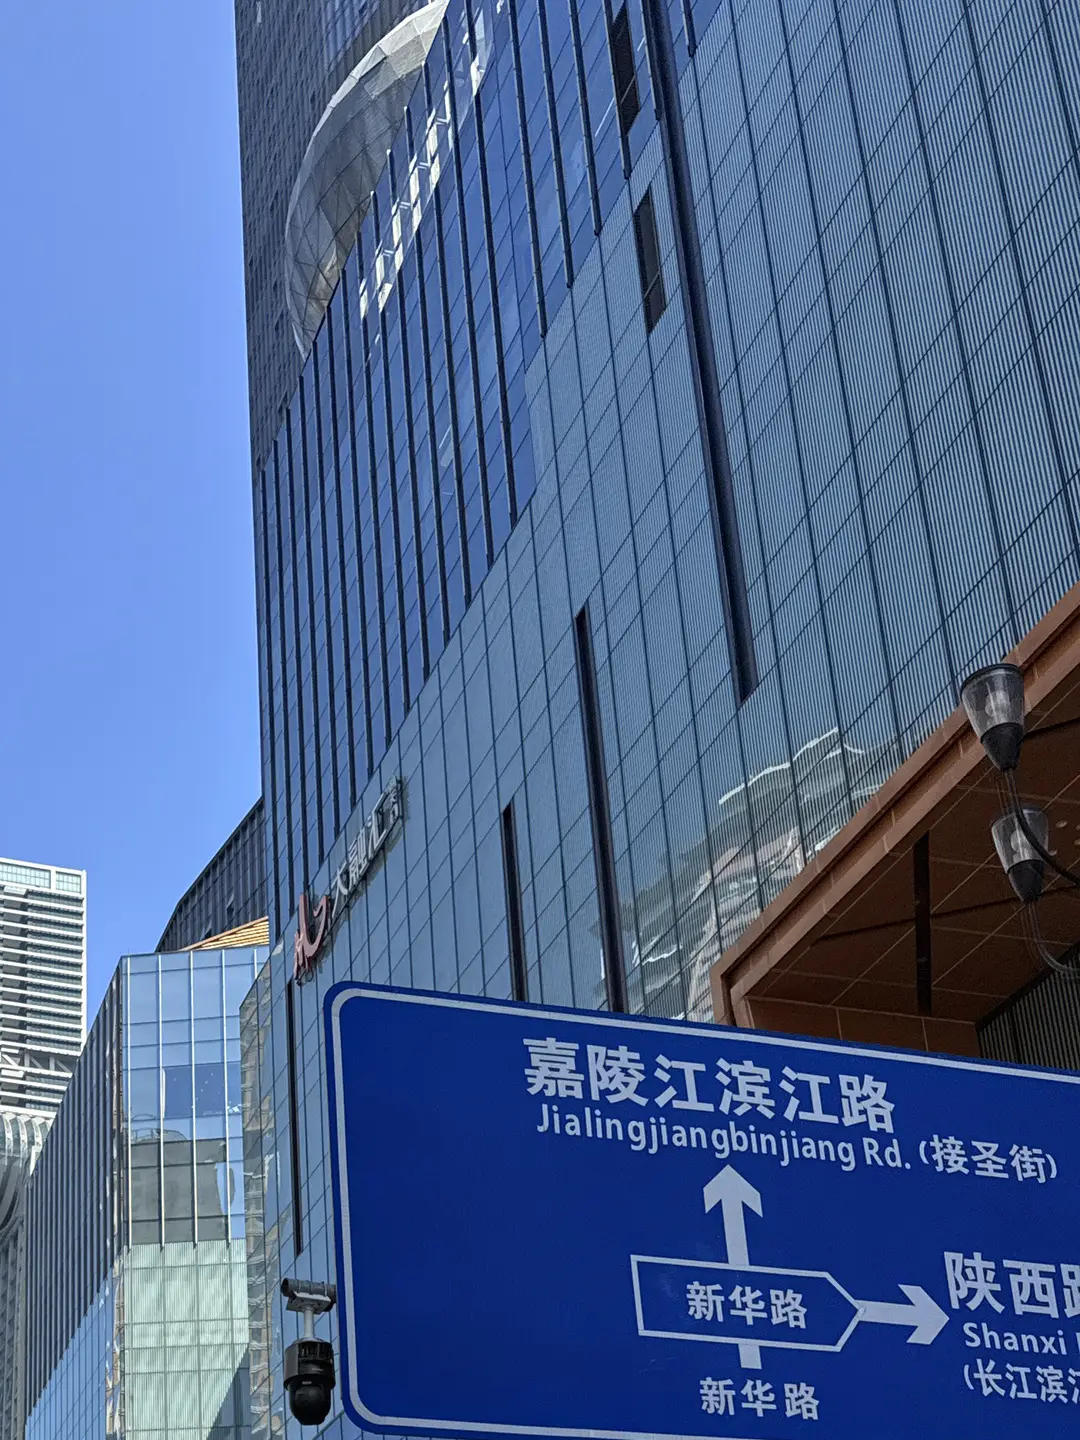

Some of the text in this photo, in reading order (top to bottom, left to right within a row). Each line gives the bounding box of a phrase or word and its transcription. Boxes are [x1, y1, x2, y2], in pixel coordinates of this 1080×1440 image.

[331, 792, 386, 918] 大融汇
[523, 1037, 895, 1133] 嘉陵江滨江路
[536, 1103, 1058, 1184] Jialingjiangbinjiang Rd. (接圣街)
[686, 1281, 807, 1329] 新华路
[963, 1322, 1067, 1355] Shanxi
[699, 1376, 820, 1421] 新华路
